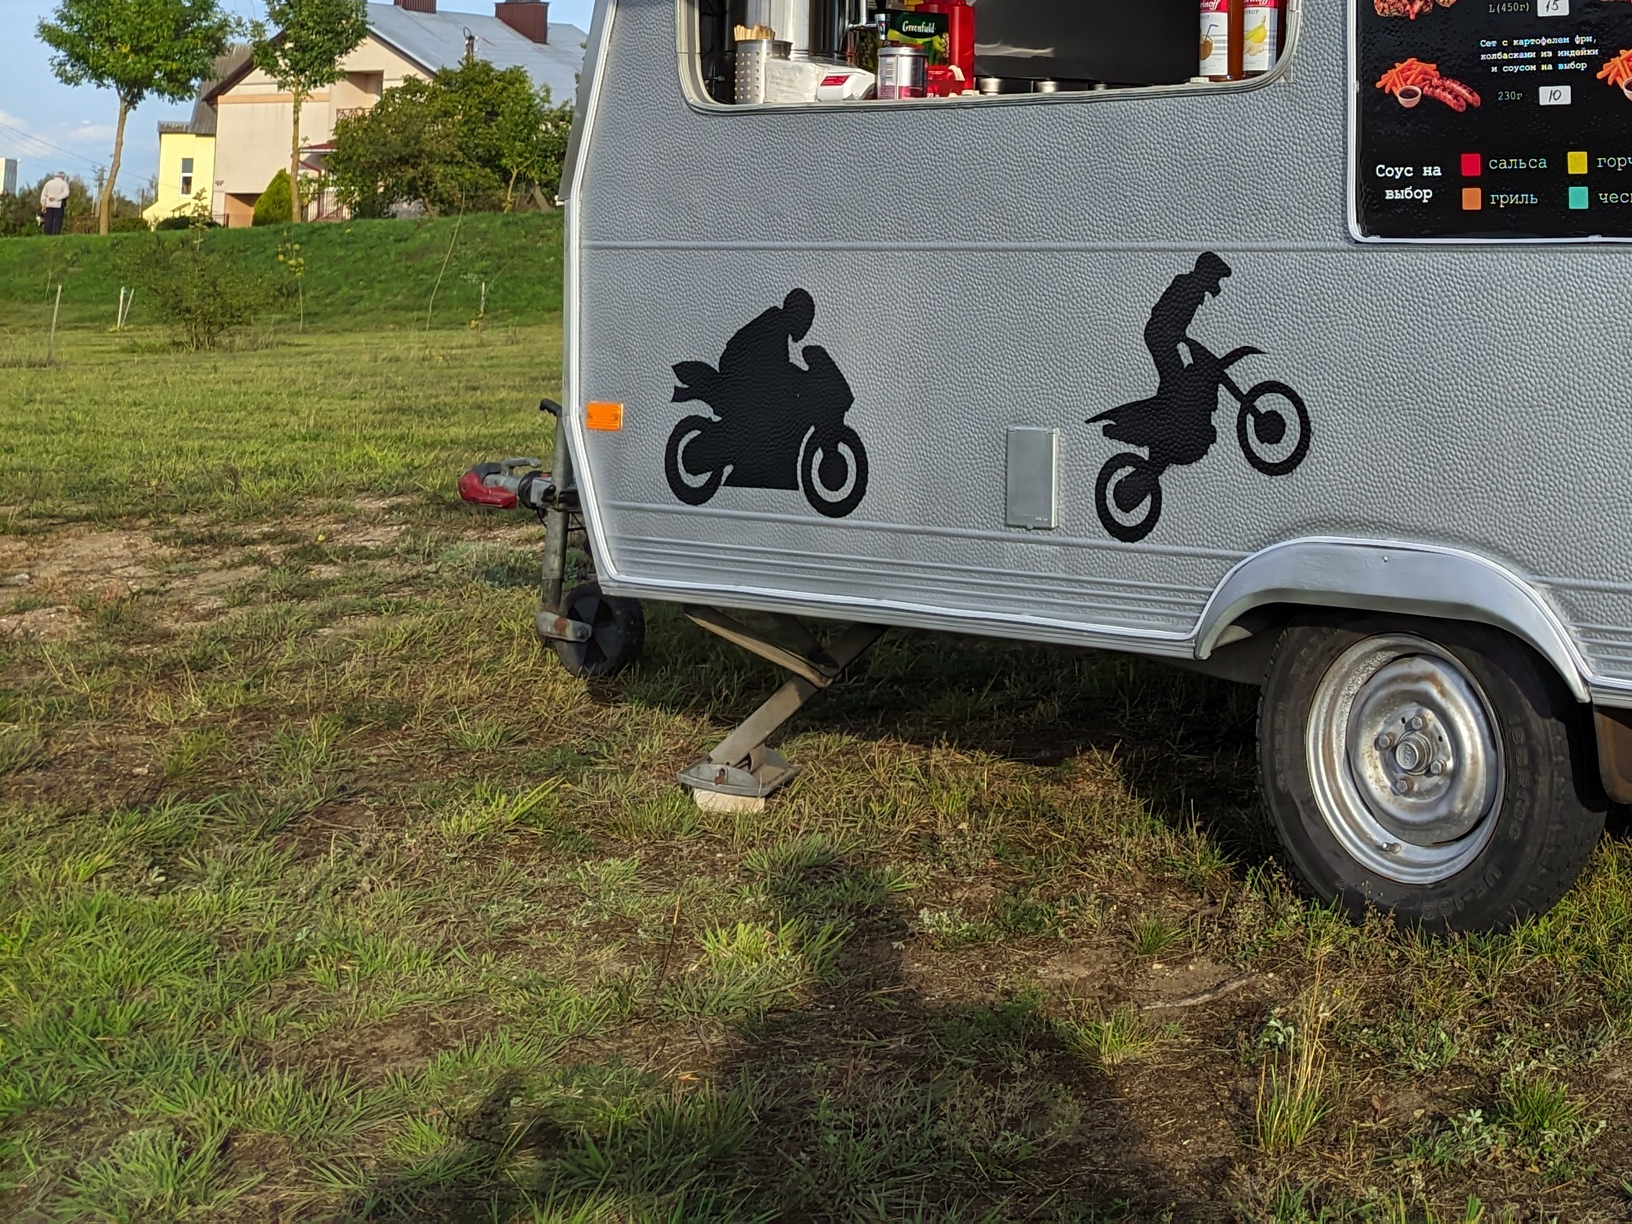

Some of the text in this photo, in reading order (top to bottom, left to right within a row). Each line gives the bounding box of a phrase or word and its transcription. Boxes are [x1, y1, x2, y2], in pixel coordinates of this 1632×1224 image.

[1545, 0, 1561, 13] 15
[902, 20, 935, 33] Greenfield
[1479, 39, 1497, 48] Сет
[1513, 36, 1570, 48] картофелем
[1574, 34, 1597, 45] фри,
[1480, 47, 1599, 60] колбасками из индейки
[1502, 64, 1537, 73] соусом
[1557, 60, 1588, 71] выбор
[1497, 90, 1523, 101] 230г
[1548, 89, 1562, 102] 10
[1488, 158, 1548, 170] сальса
[1375, 164, 1442, 179] Соус на
[1385, 185, 1433, 203] выбор
[1490, 193, 1538, 208] гриль
